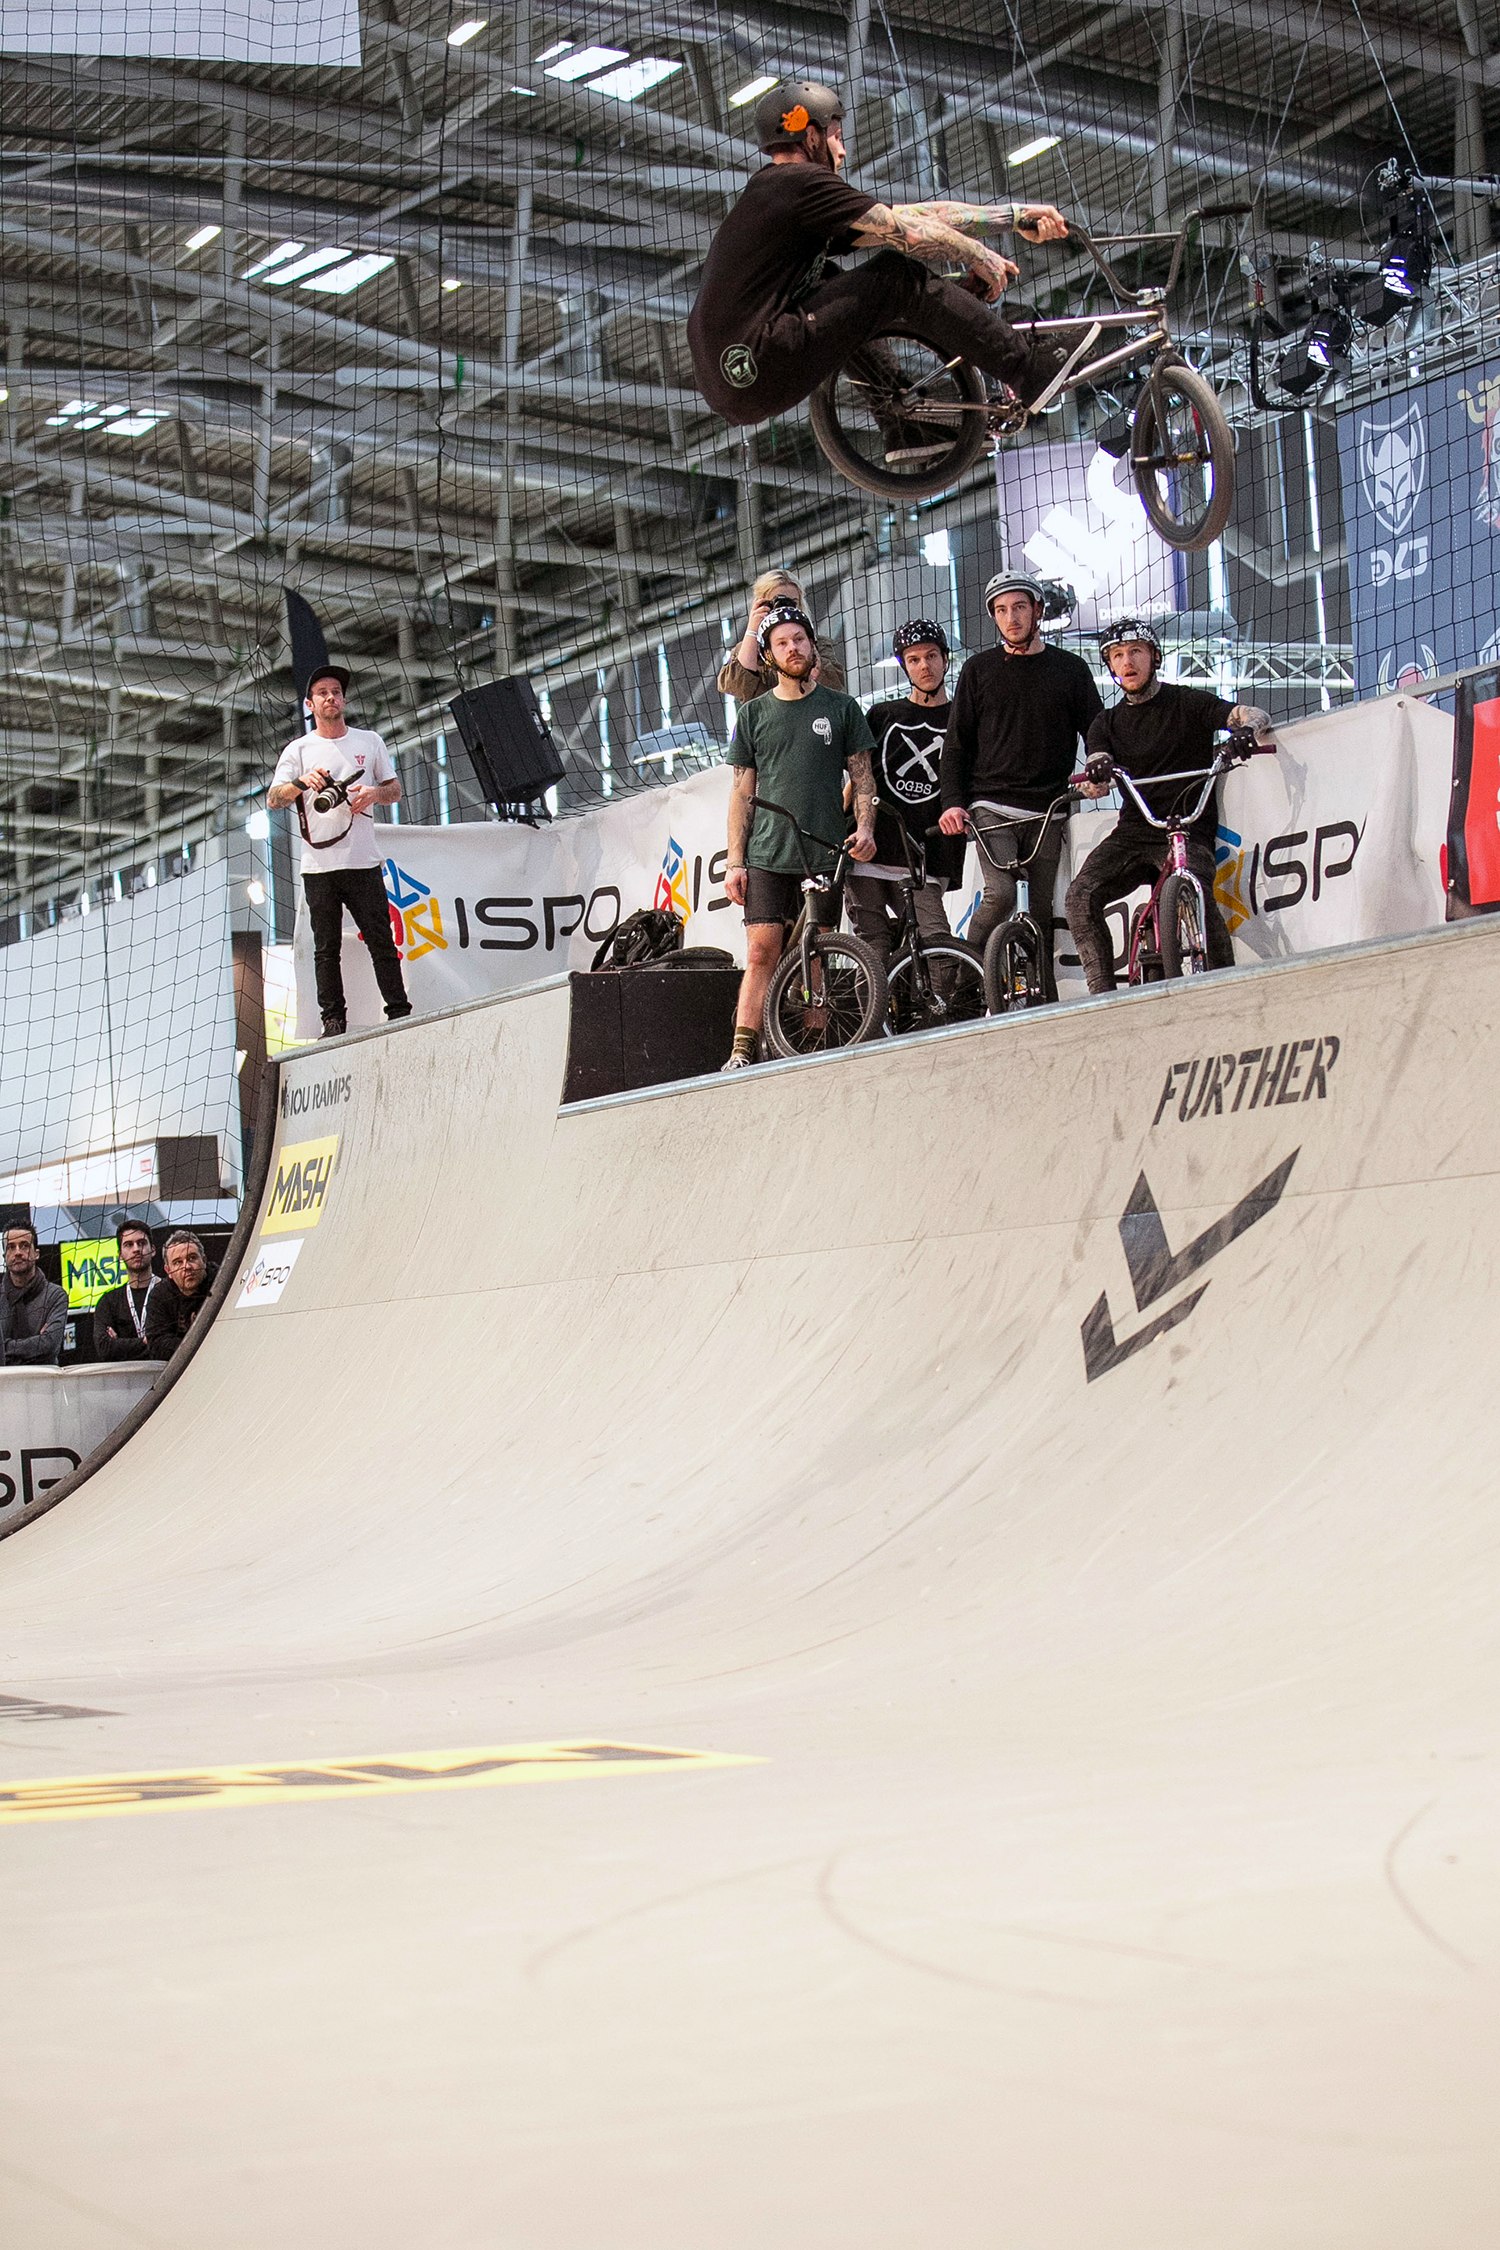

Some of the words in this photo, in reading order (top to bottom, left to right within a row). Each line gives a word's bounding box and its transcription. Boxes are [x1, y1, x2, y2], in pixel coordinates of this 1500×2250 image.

[1099, 601, 1172, 620] DISTUTION
[896, 780, 932, 795] OGBS
[1249, 811, 1368, 915] ISP
[454, 886, 622, 952] ISPO
[312, 1073, 352, 1111] RAMPS
[1151, 1035, 1341, 1127] FURTHER
[267, 1154, 333, 1217] MASH
[259, 1265, 291, 1288] ISPO
